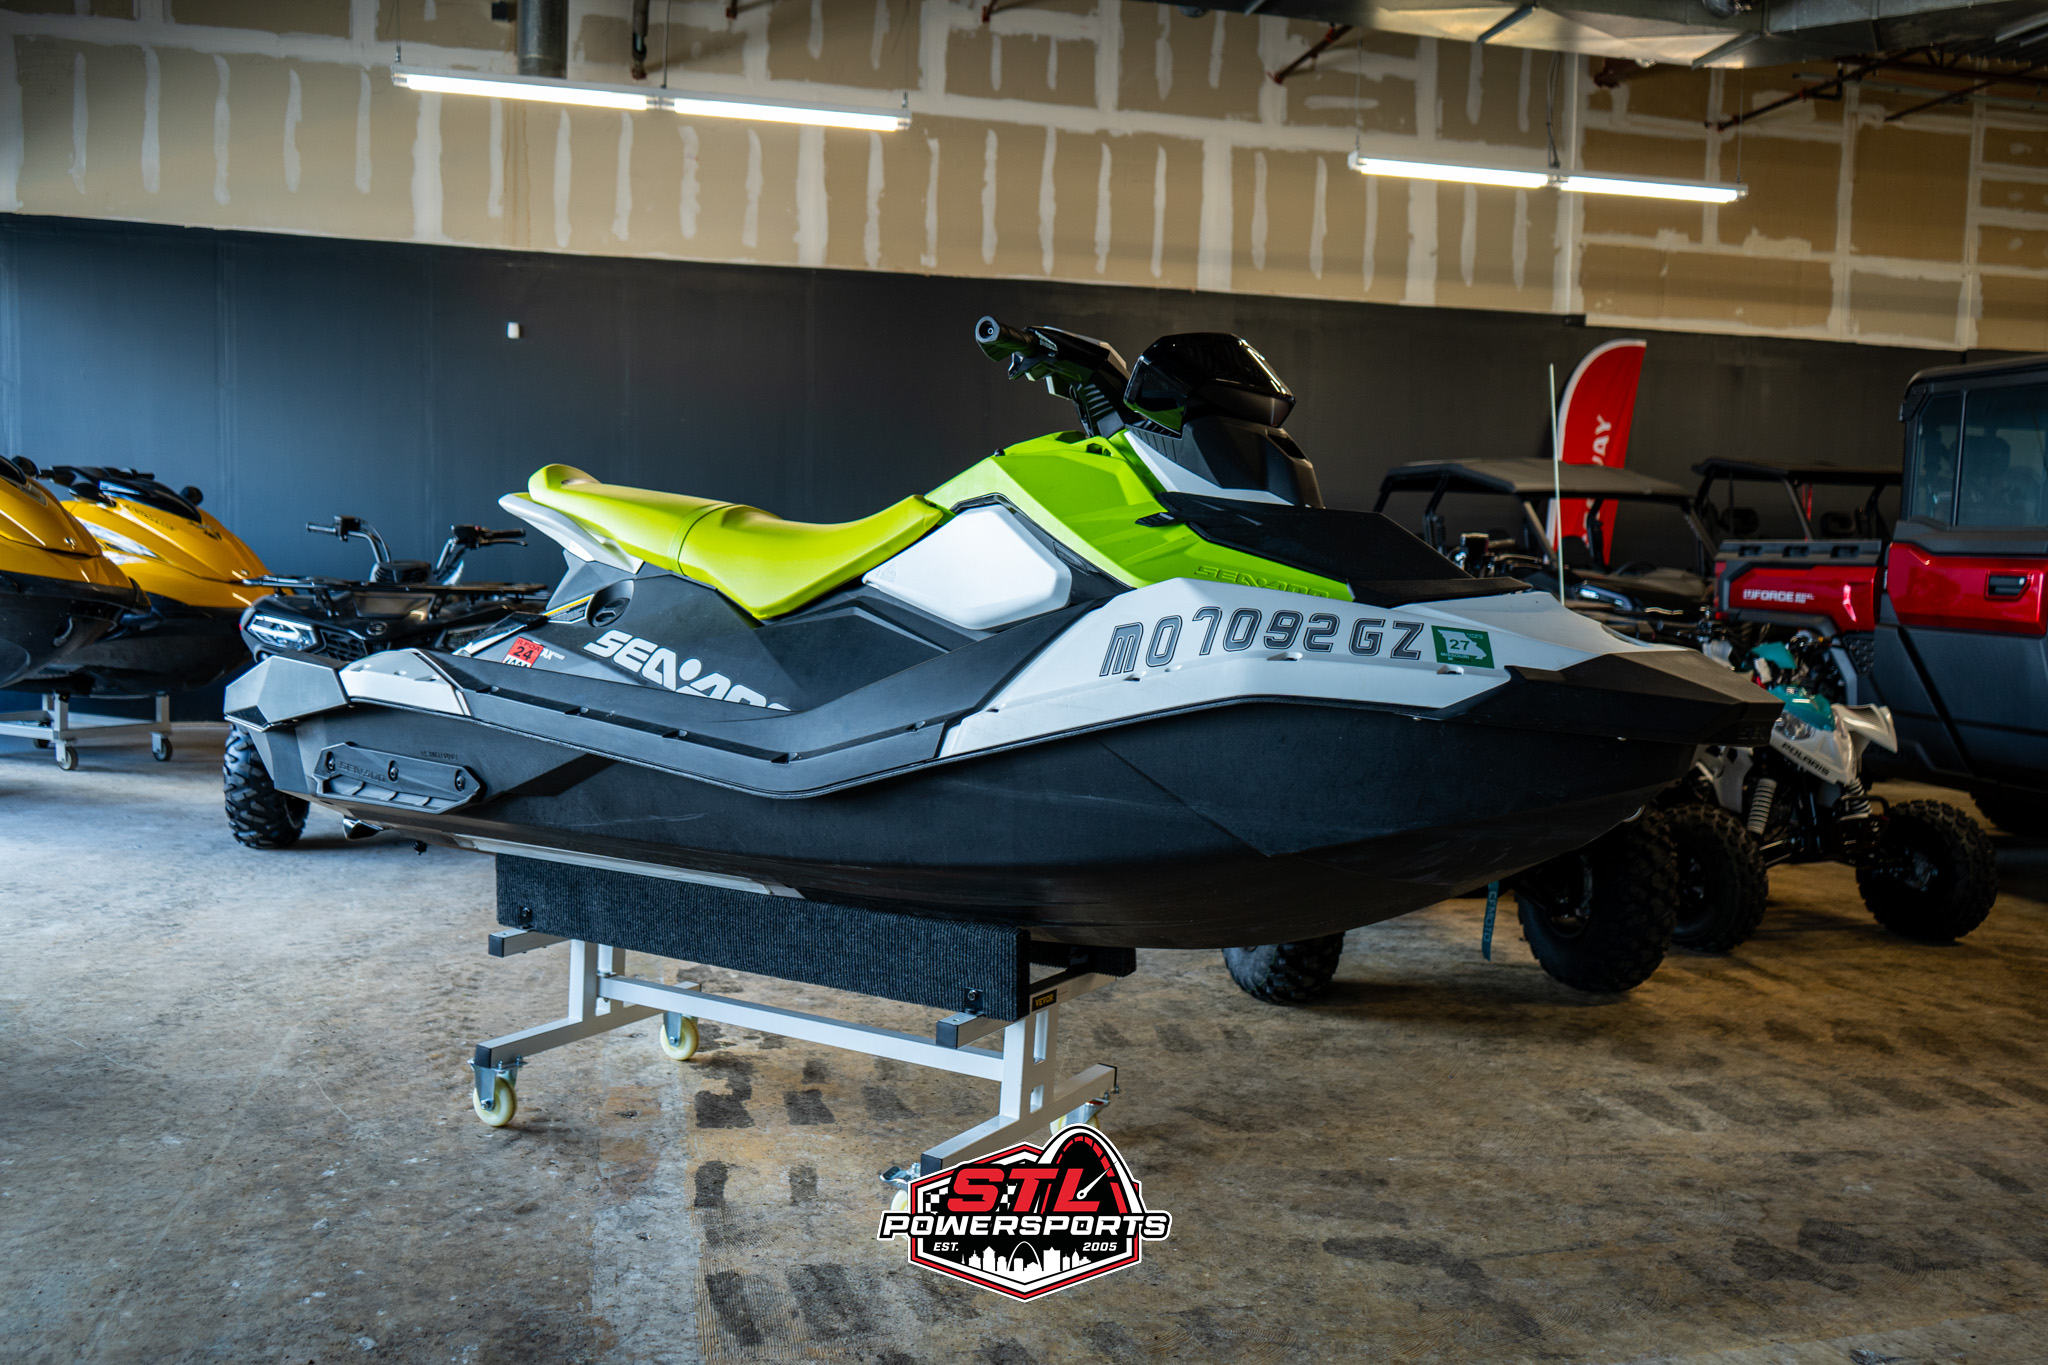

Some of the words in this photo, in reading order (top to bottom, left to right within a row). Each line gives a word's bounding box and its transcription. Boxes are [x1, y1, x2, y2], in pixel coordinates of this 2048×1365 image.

[1192, 606, 1340, 657] 7092
[1348, 617, 1425, 661] GZ
[1449, 638, 1470, 651] 27
[513, 646, 534, 661] 24
[1781, 742, 1831, 777] POLARIS
[1483, 891, 1497, 943] CFMOTO
